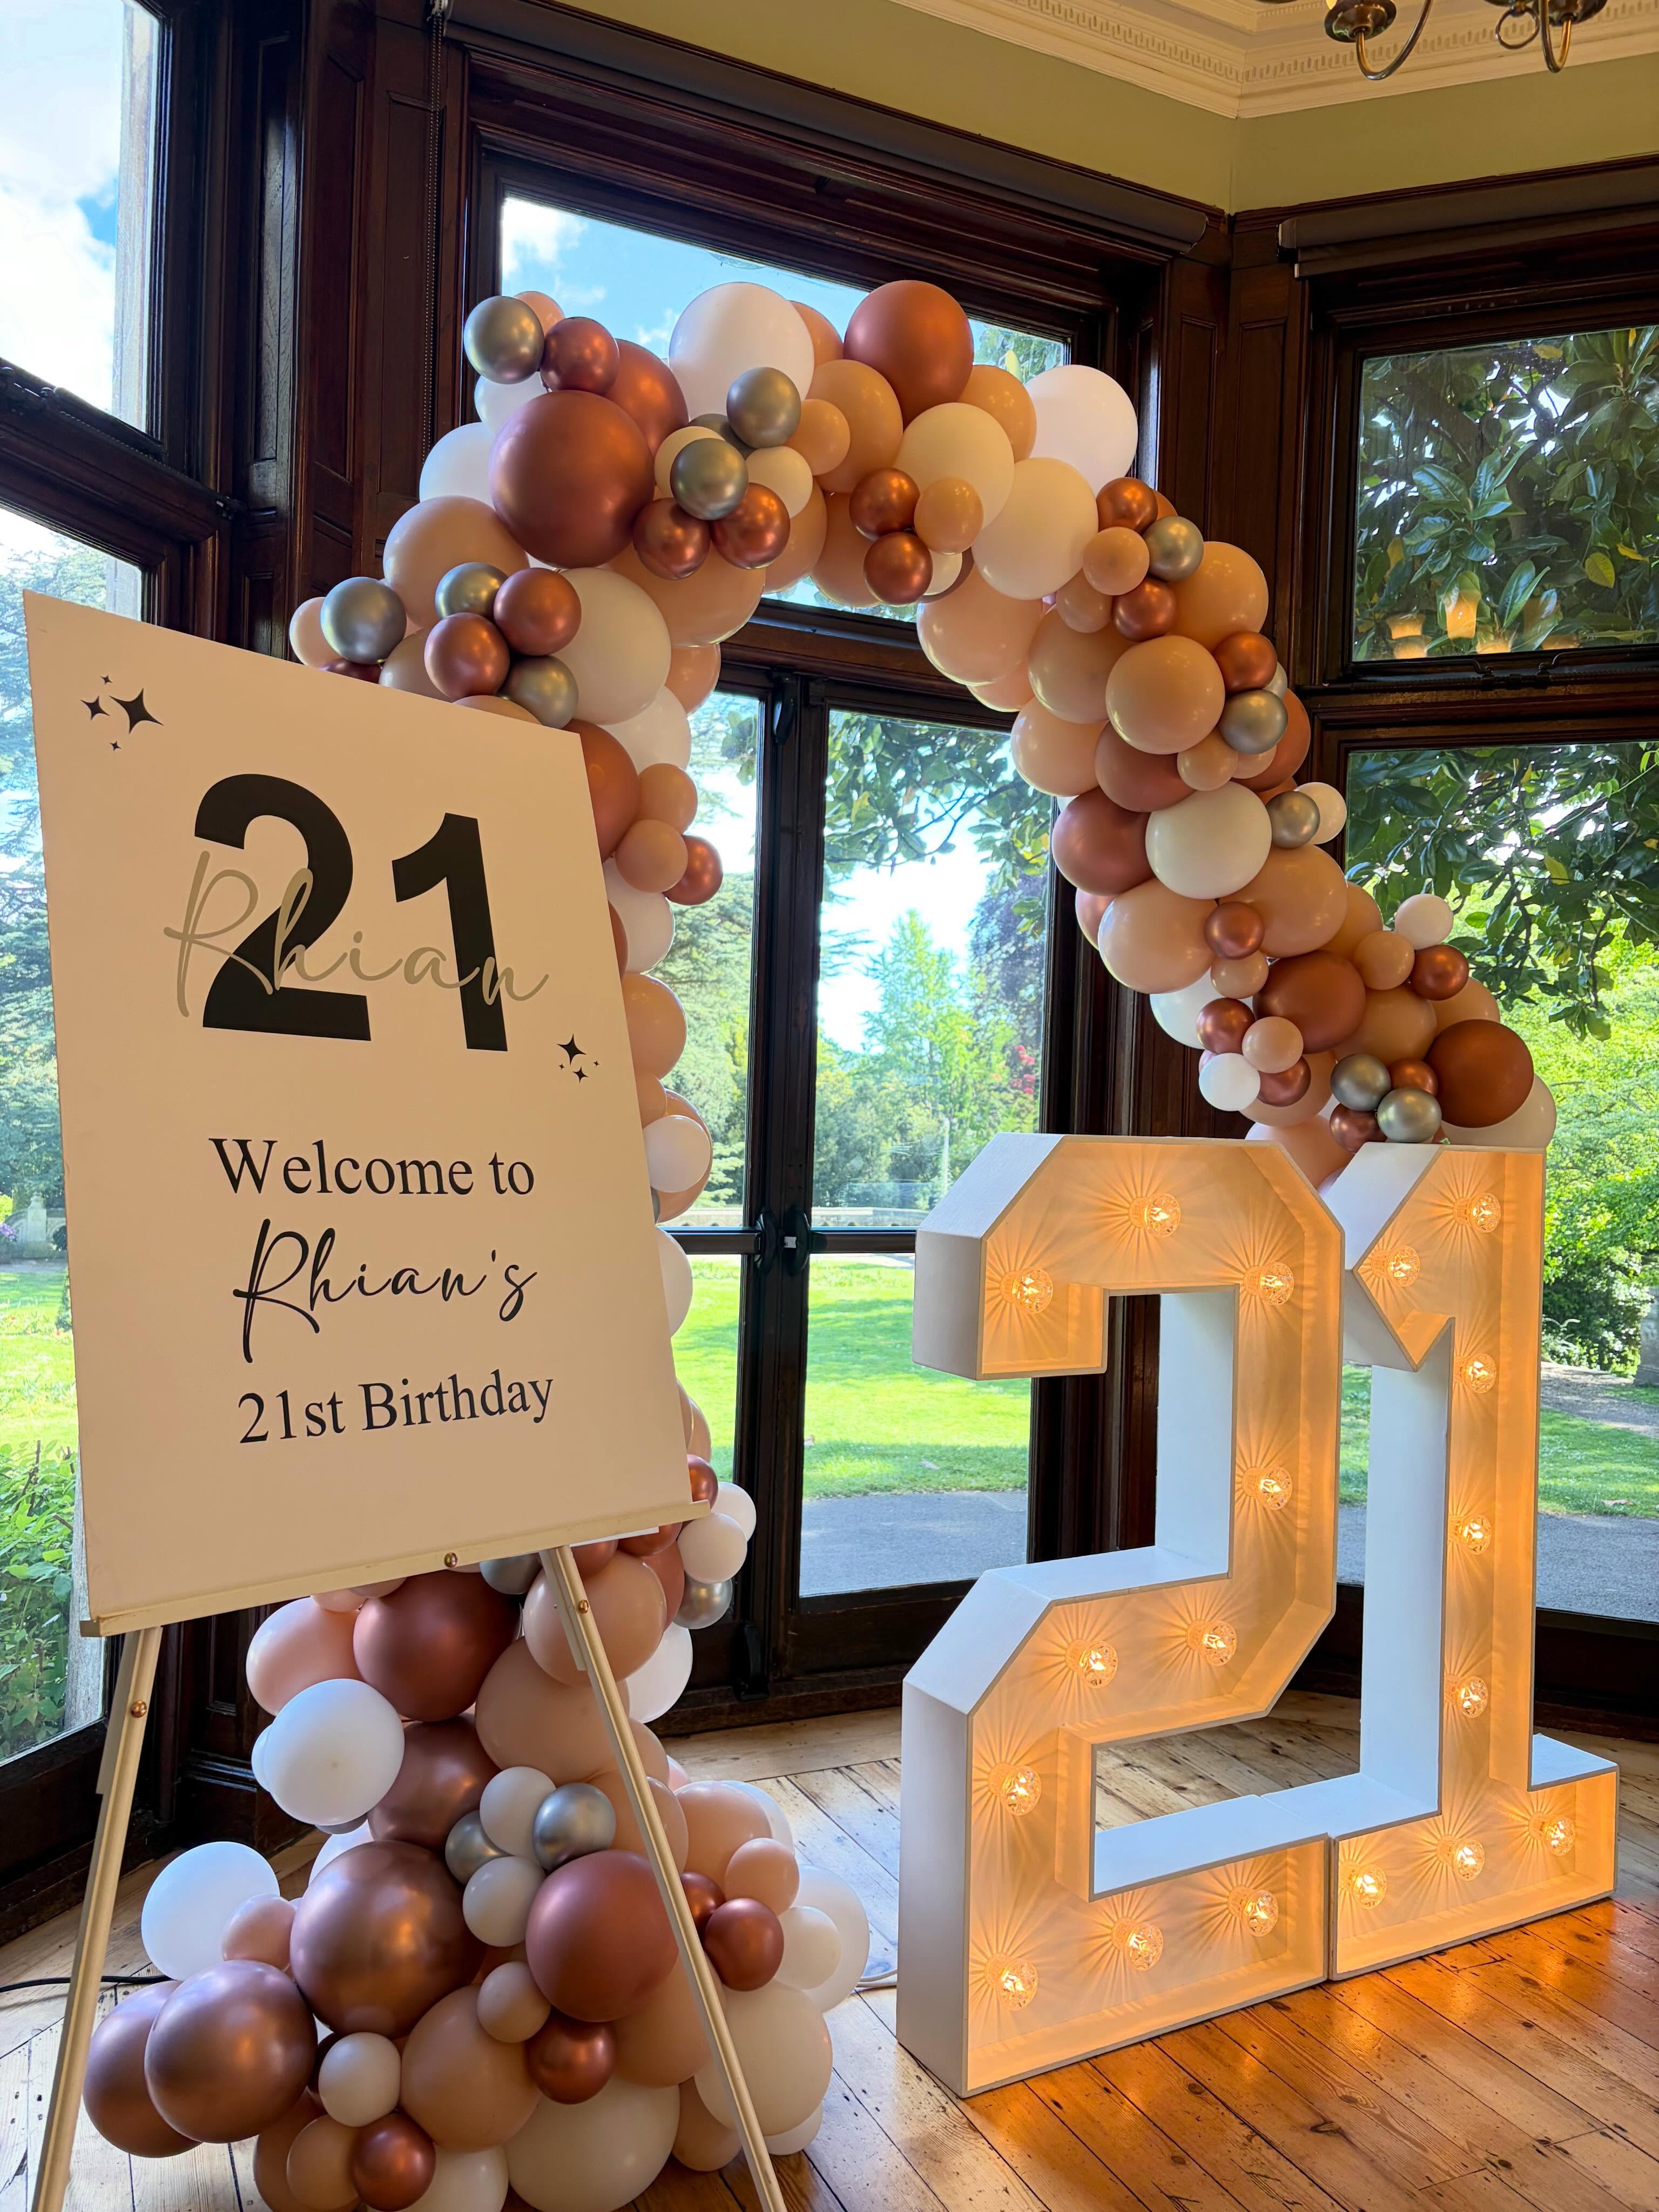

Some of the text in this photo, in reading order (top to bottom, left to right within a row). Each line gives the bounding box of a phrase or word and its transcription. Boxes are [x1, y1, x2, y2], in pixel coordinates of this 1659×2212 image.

[163, 850, 550, 1018] Rhian
[194, 773, 508, 1051] 21
[208, 1137, 535, 1195] Welcome to
[232, 1218, 537, 1364] Rhian's
[238, 1369, 553, 1444] 21st Birthday
[898, 1133, 1617, 2099] 21
